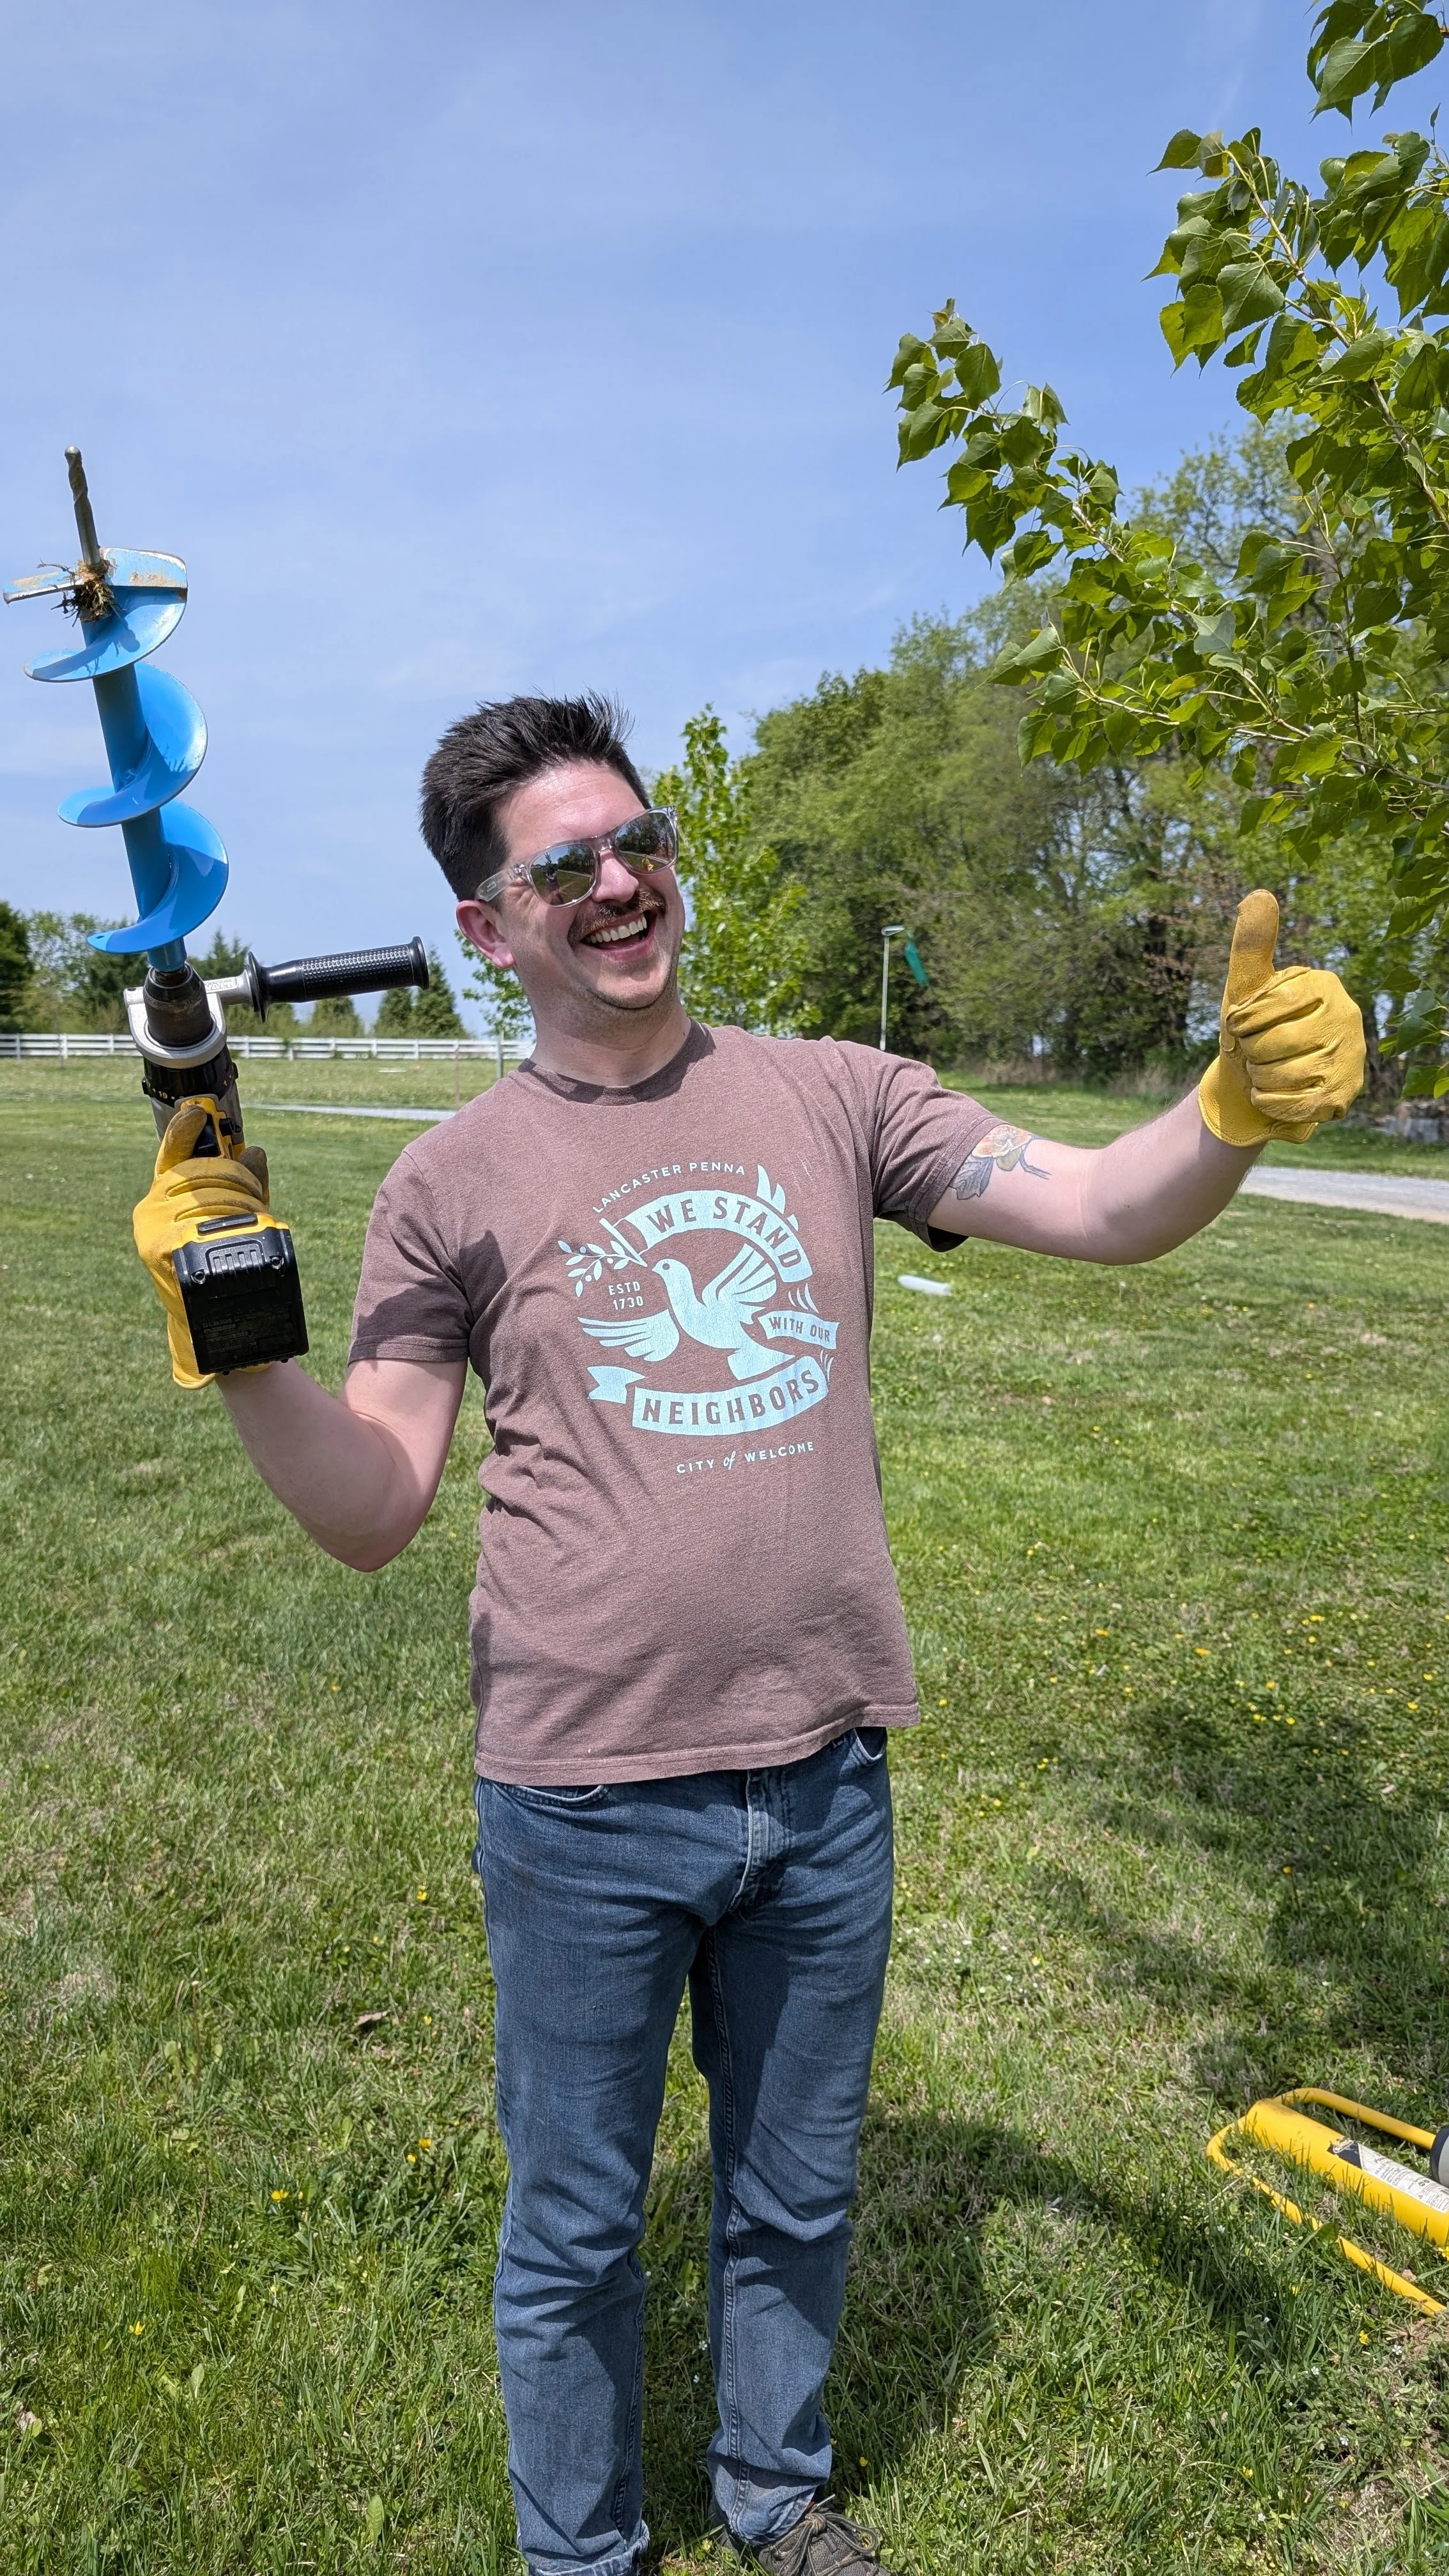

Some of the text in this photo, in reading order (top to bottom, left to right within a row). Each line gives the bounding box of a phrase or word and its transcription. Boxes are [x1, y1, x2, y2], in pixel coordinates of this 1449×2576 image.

[592, 1162, 746, 1213] LANCASTER PENNA
[647, 1196, 802, 1269] WE STAND
[608, 1281, 641, 1296] ESTD
[613, 1296, 644, 1310] 1730
[769, 1316, 831, 1343] WITH OUR
[641, 1369, 819, 1425] NEIGHBORS
[677, 1441, 815, 1474] CITY of WELCOME
